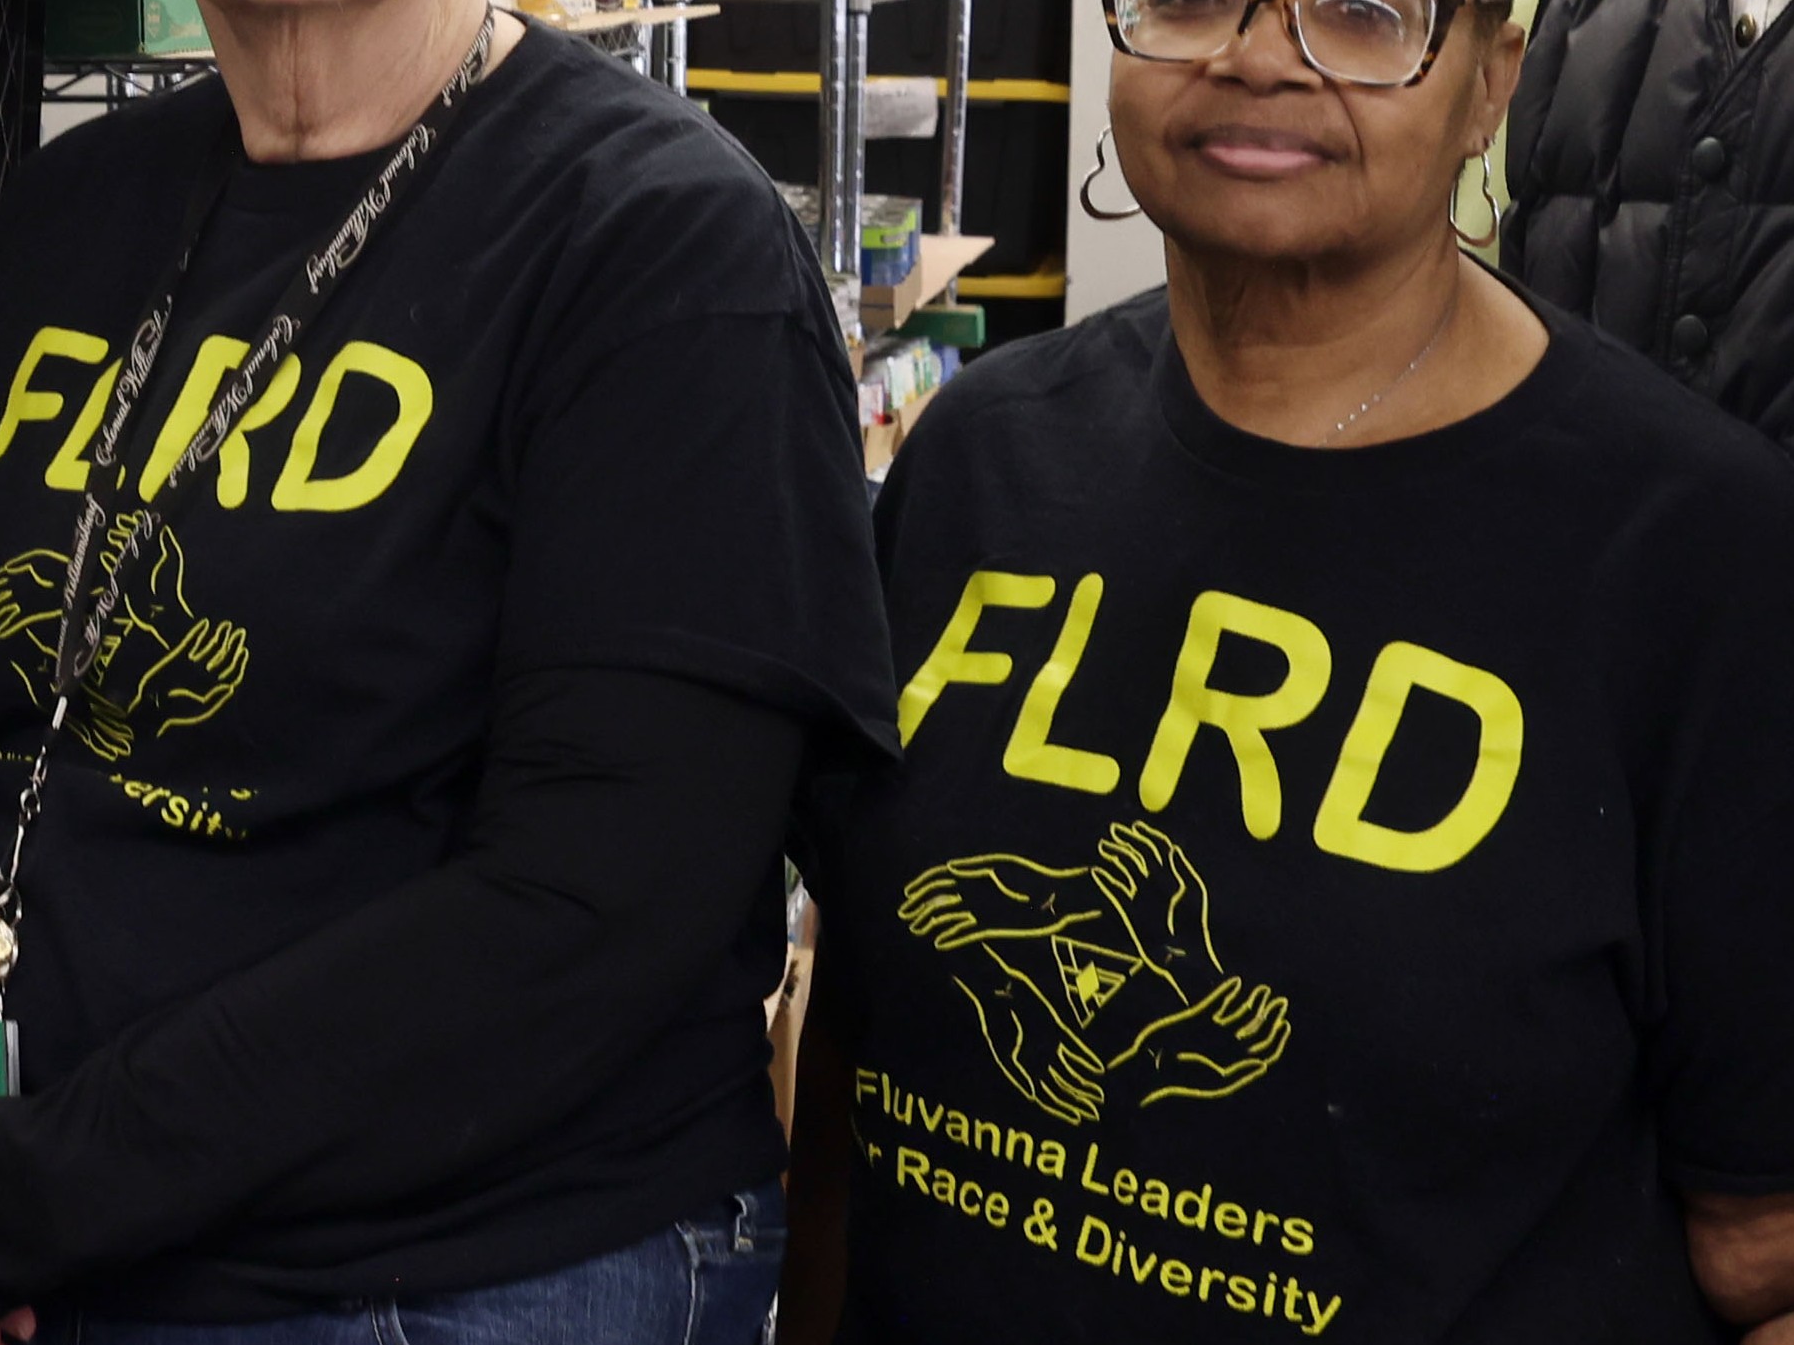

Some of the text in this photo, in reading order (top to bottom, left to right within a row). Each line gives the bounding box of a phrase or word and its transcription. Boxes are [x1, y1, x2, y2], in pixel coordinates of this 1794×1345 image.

[897, 569, 1524, 873] FLRD
[854, 1065, 1067, 1179] Fluvanna
[1082, 1143, 1316, 1256] Leaders
[896, 1148, 1342, 1337] Race & Diversity
